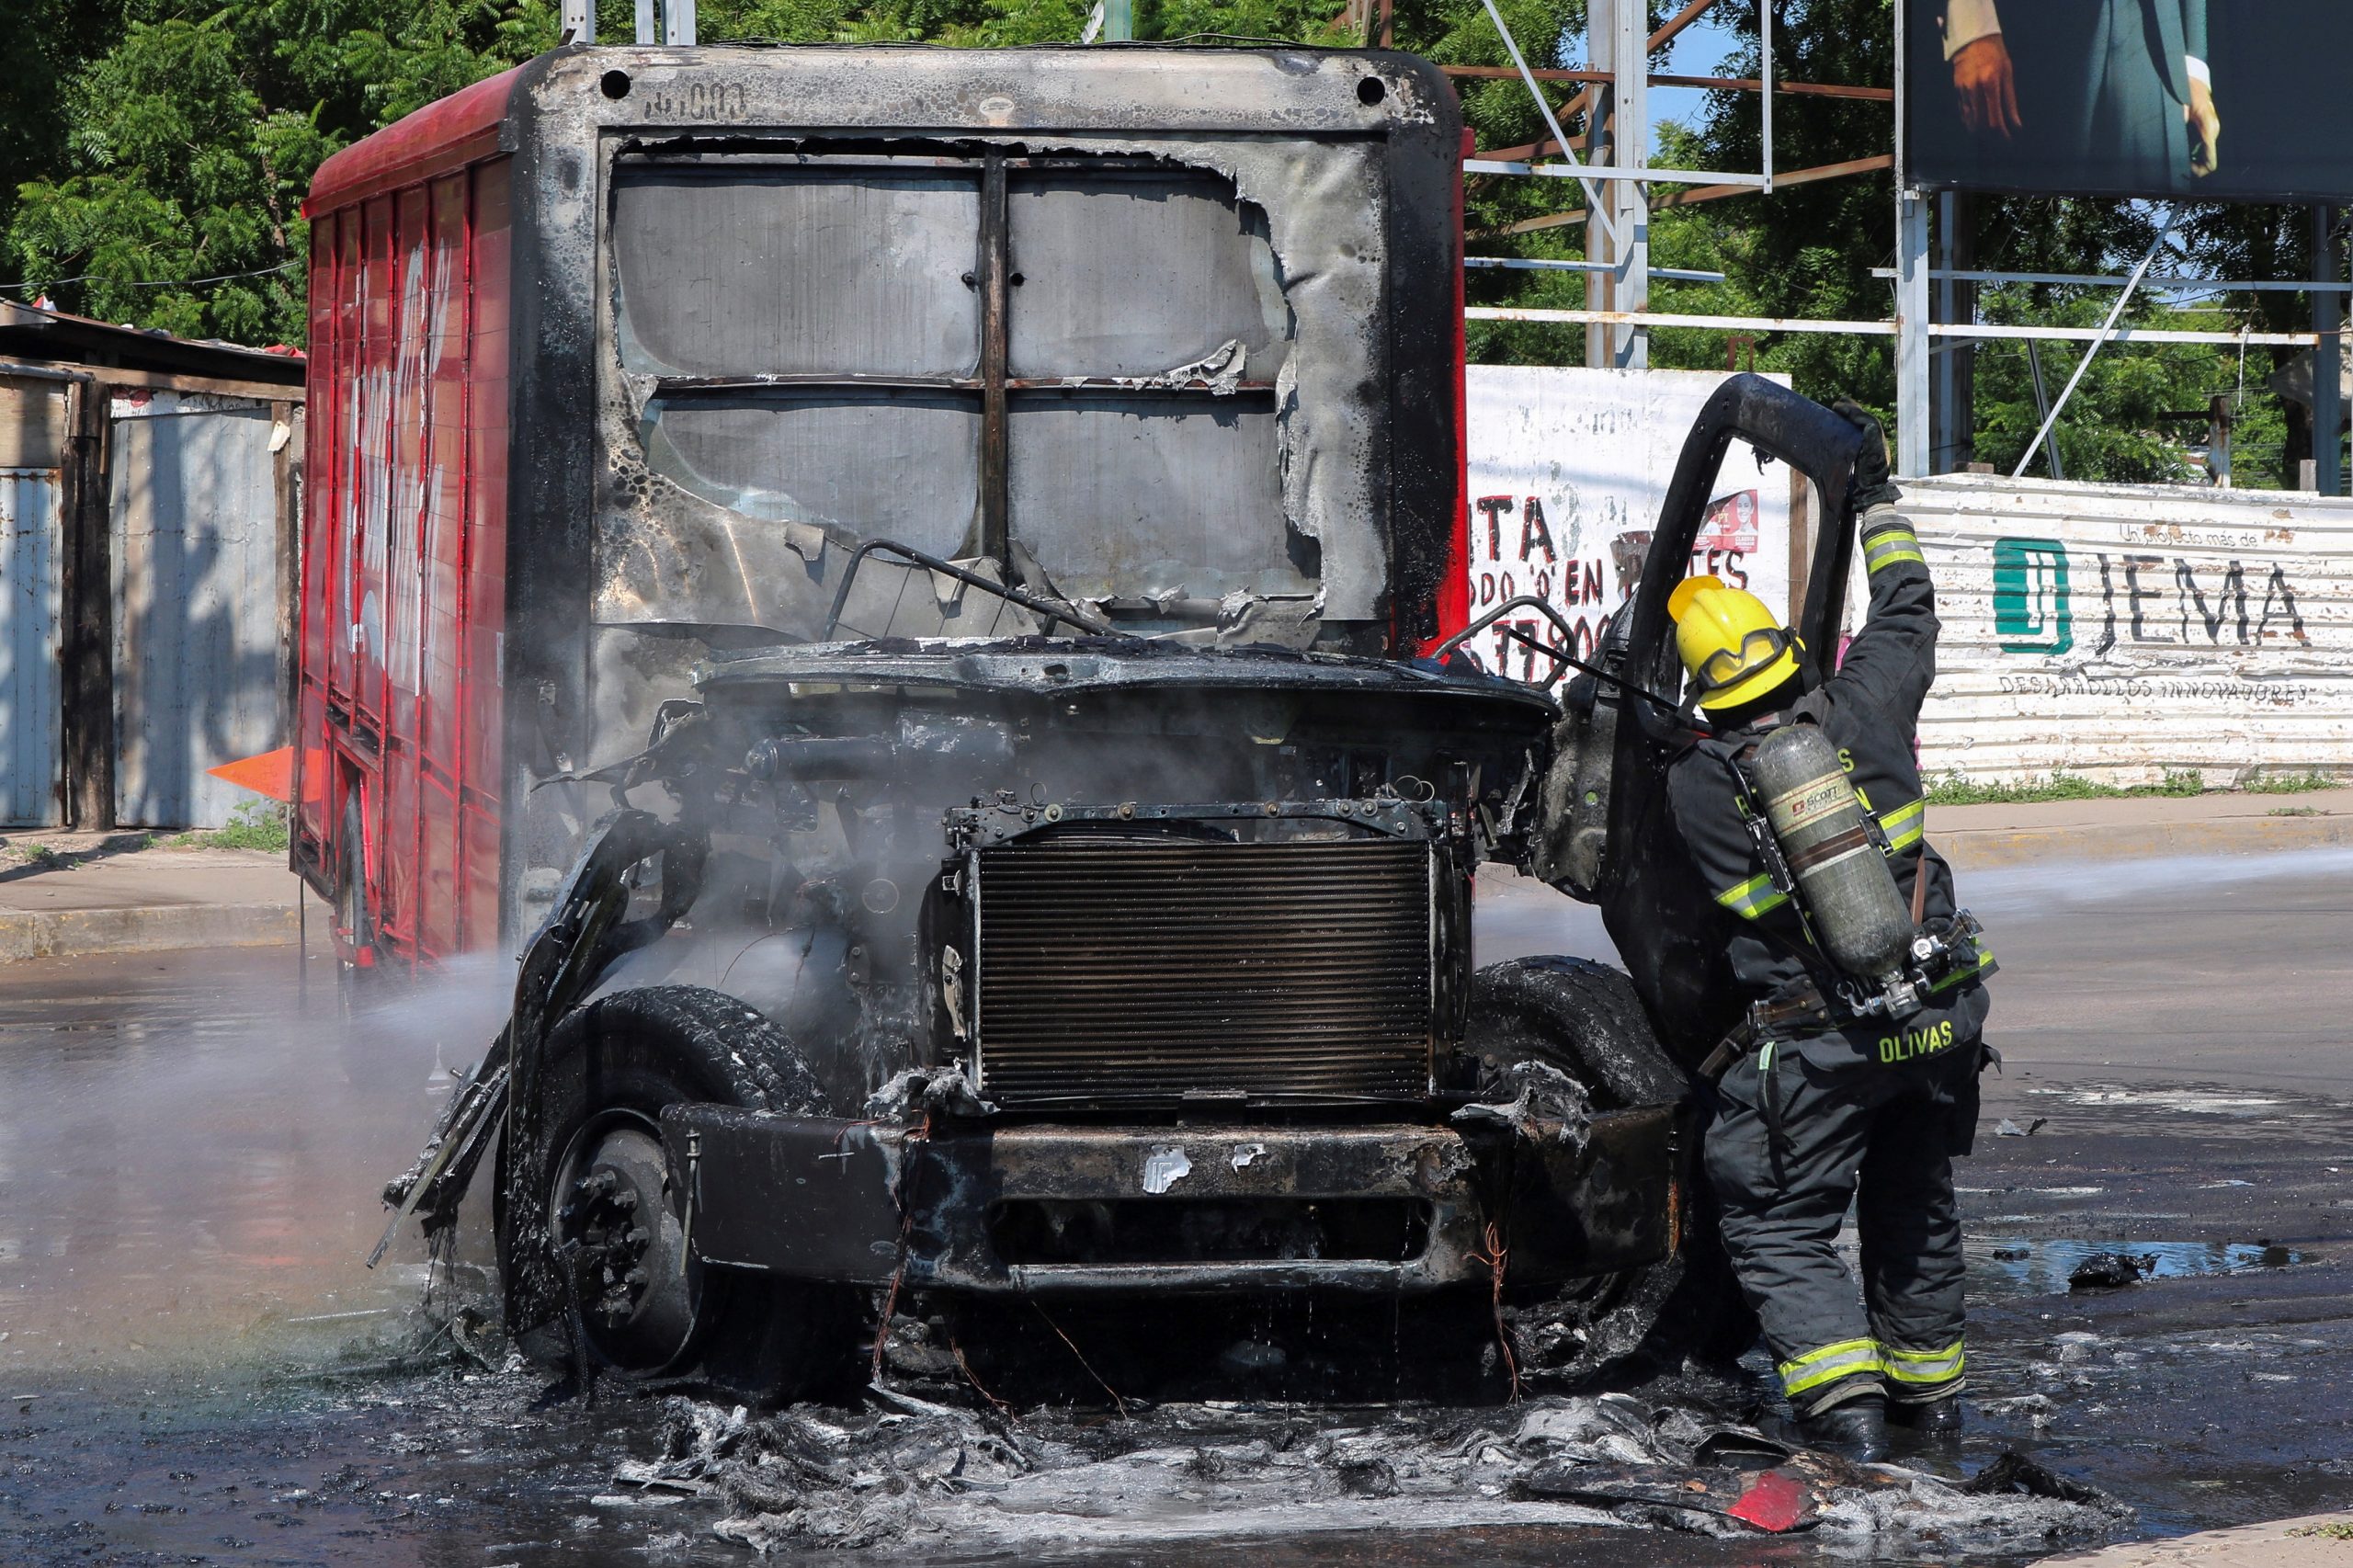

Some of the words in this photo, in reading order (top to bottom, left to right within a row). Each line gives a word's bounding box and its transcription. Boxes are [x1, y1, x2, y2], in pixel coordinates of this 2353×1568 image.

[1469, 495, 1557, 563] TA
[2120, 524, 2141, 542] Un
[2143, 529, 2203, 546] proyecto
[2207, 530, 2235, 547] más
[2240, 532, 2258, 547] de
[1565, 559, 1603, 608] EN
[2095, 553, 2313, 656] JEMA
[1998, 676, 2153, 698] DESARROLLOS
[2160, 681, 2307, 702] INNOVADORES
[1806, 786, 1838, 807] SCOTT
[1879, 1020, 1953, 1063] OLIVAS
